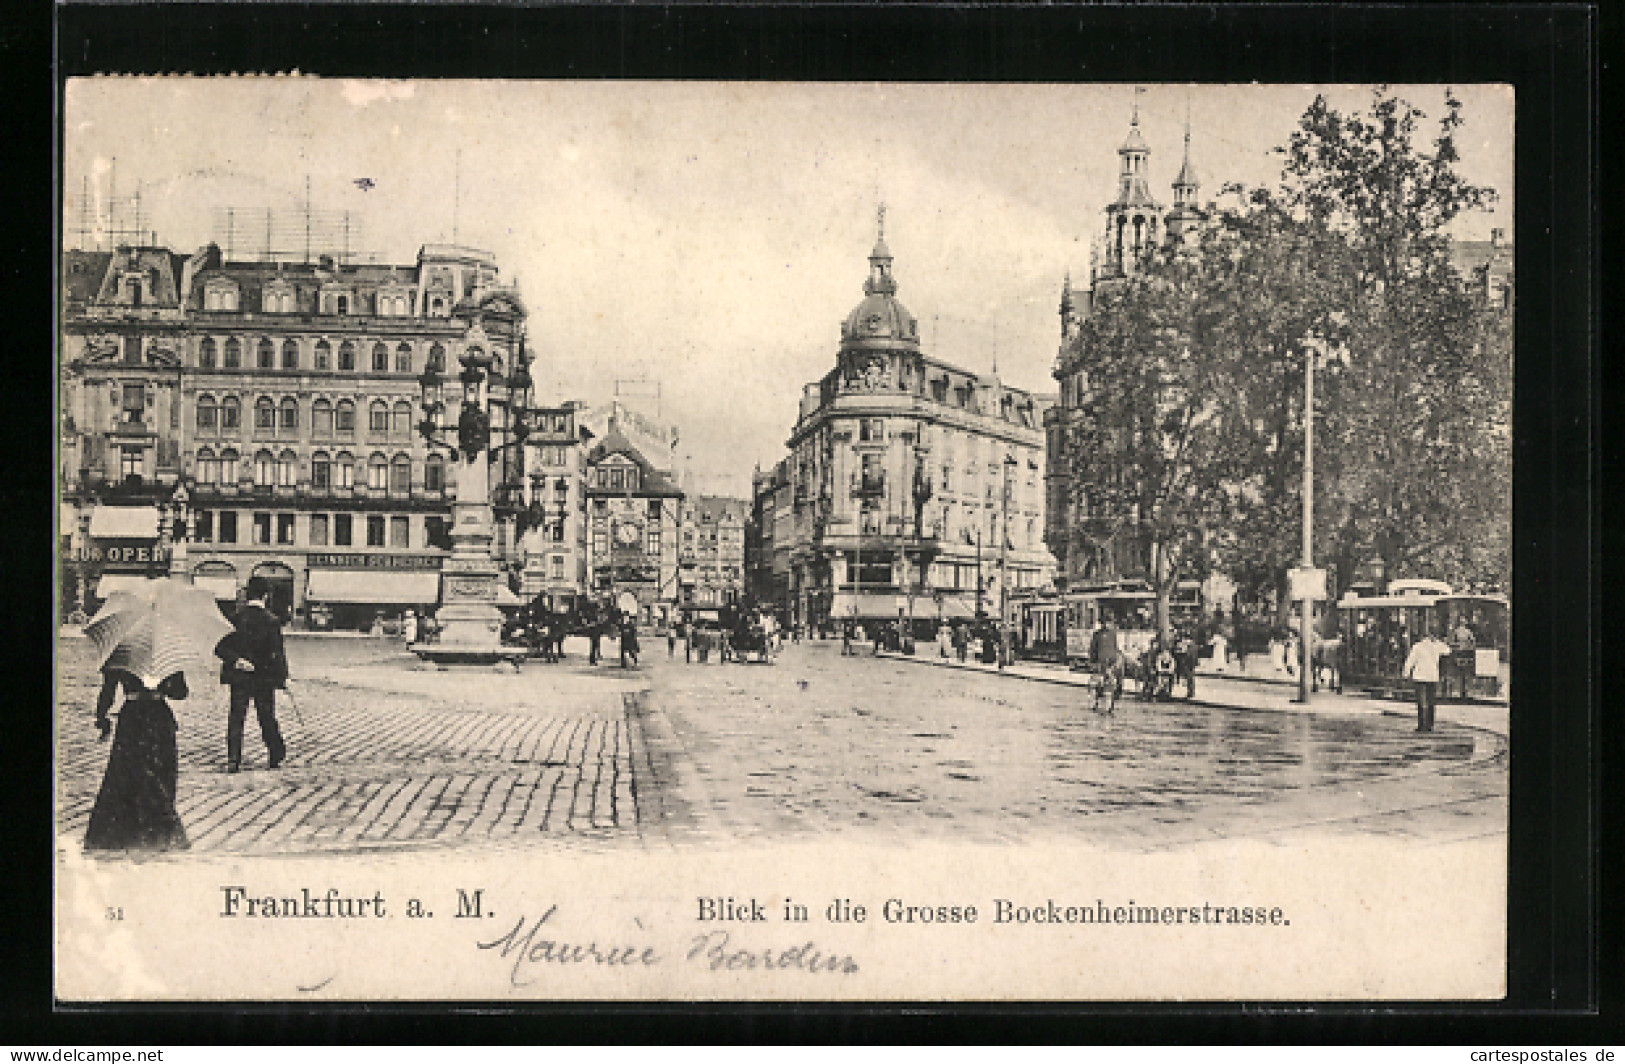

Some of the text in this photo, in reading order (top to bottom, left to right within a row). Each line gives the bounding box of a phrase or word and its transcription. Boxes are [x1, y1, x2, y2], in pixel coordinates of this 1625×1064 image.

[220, 886, 494, 919] Frankfurt a. M.
[696, 898, 1291, 926] Blick in die Grosse Bockenheimerstrasse.
